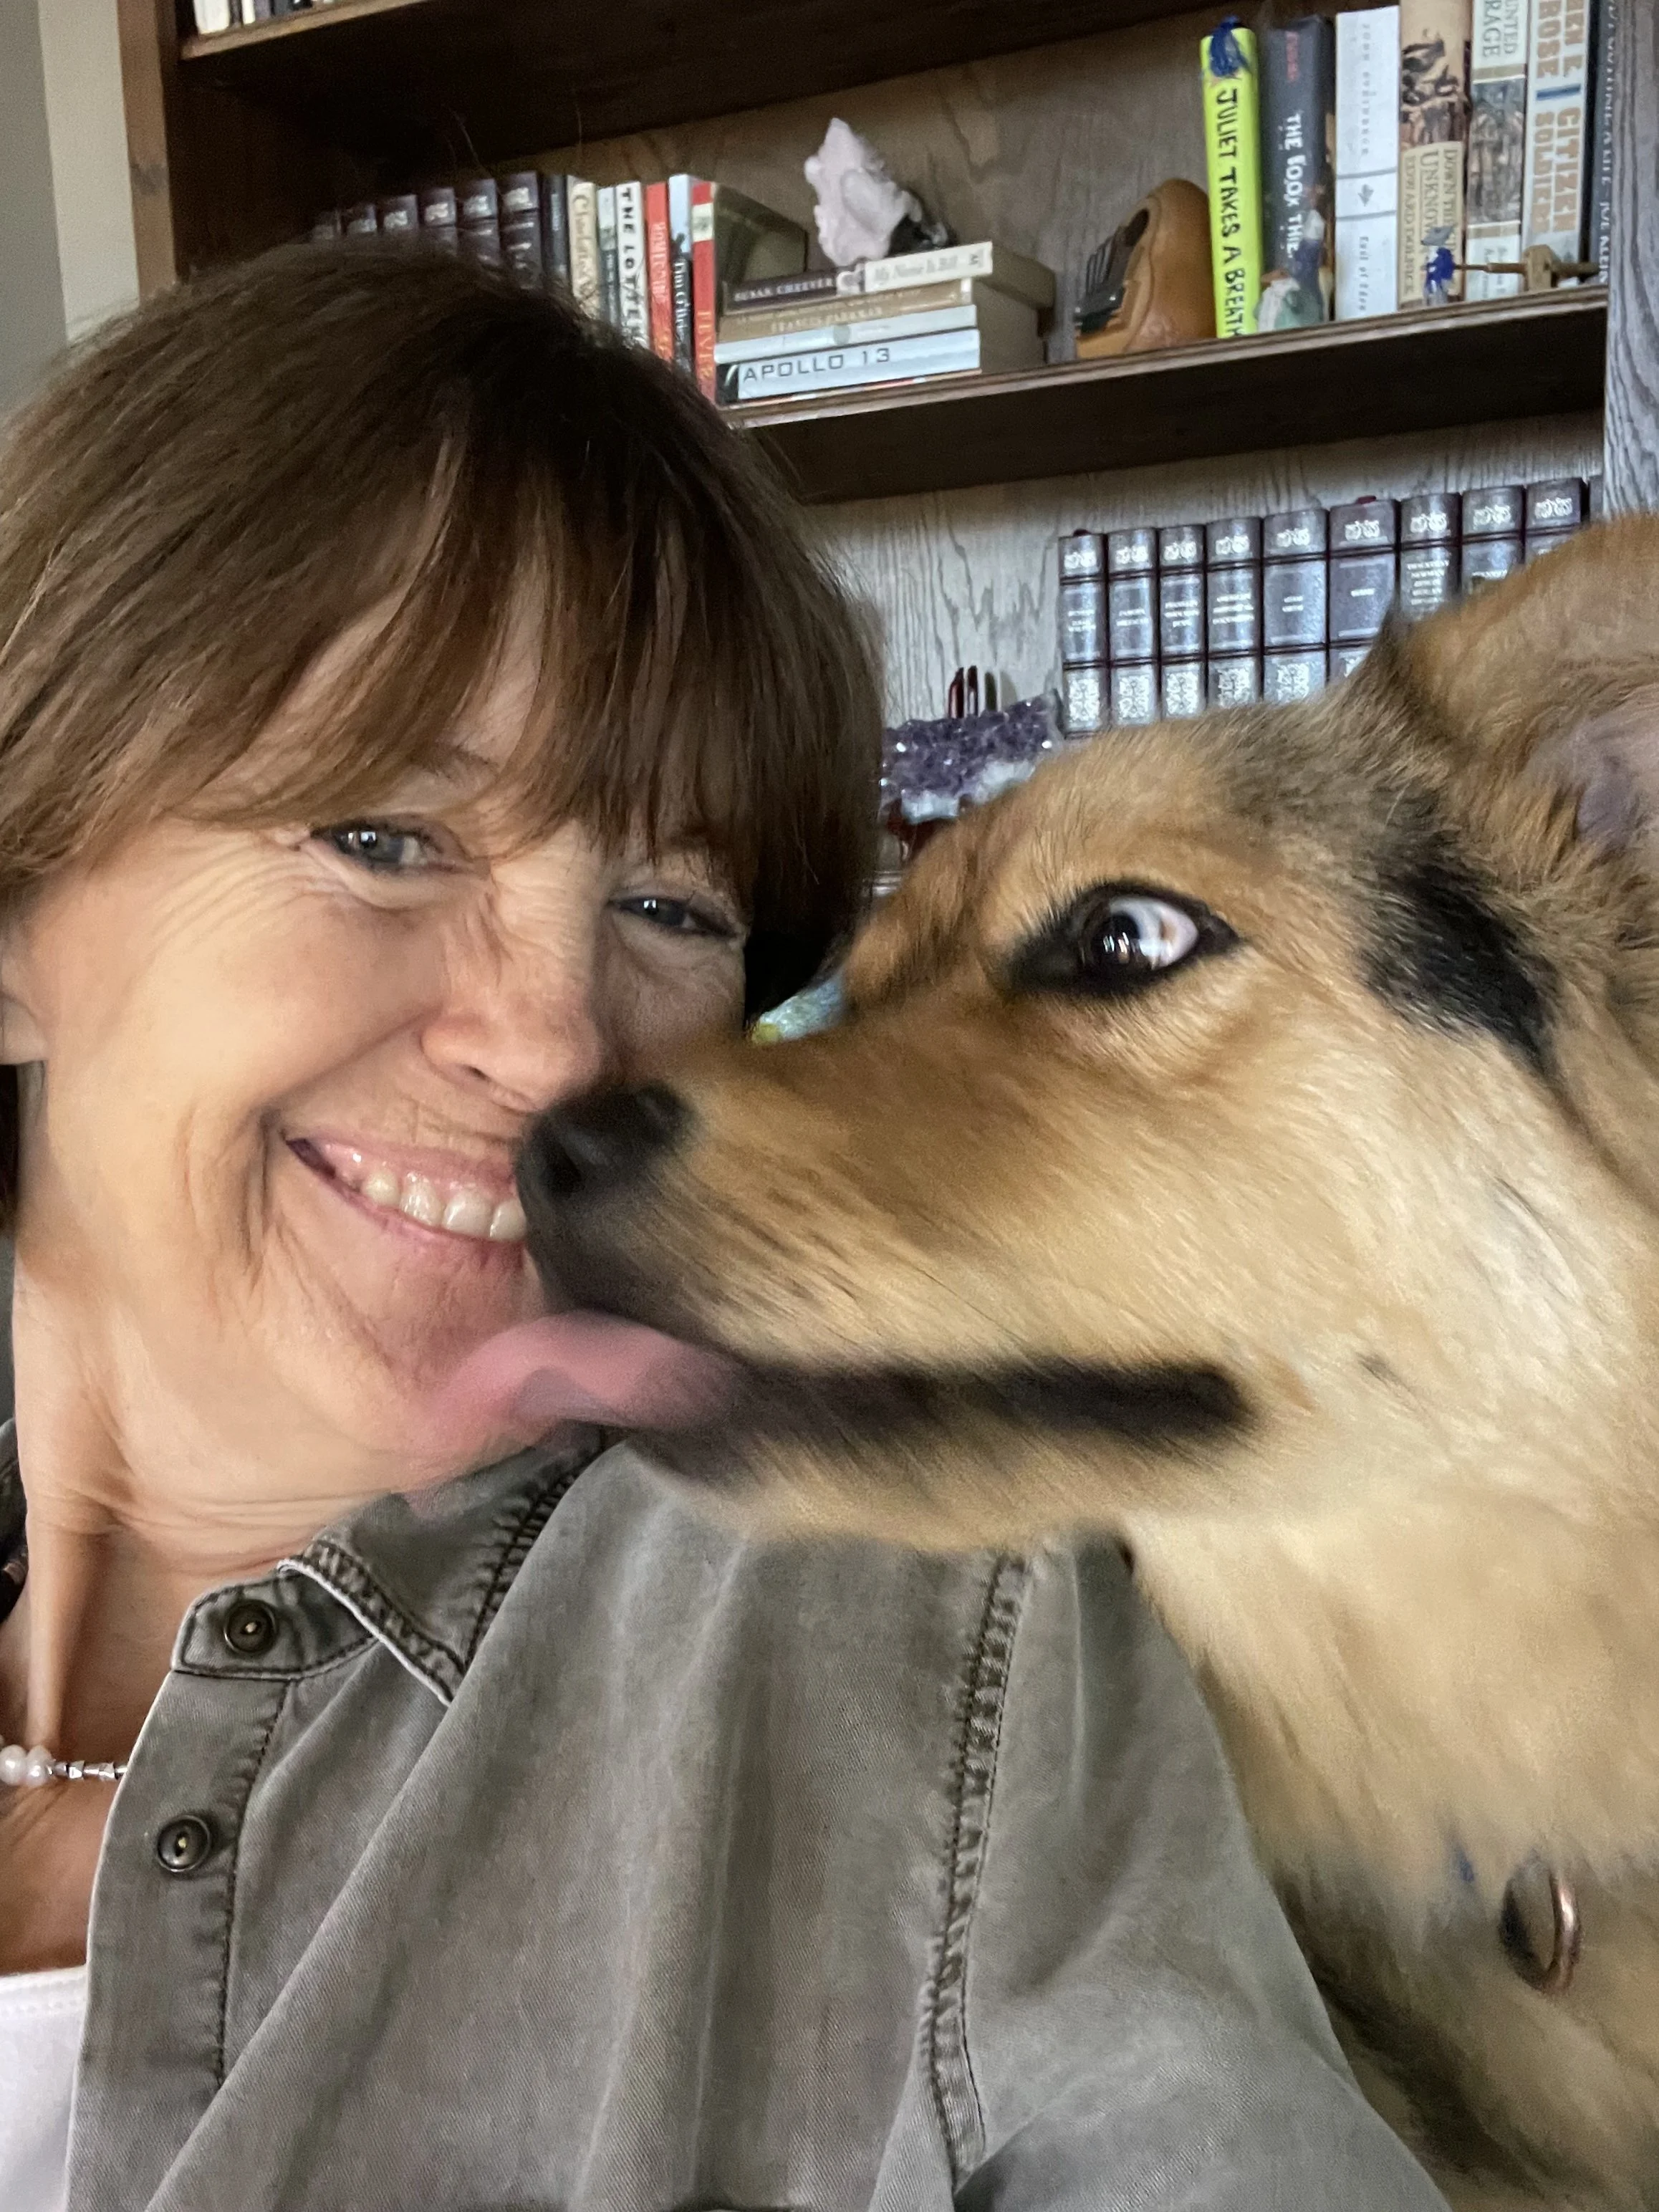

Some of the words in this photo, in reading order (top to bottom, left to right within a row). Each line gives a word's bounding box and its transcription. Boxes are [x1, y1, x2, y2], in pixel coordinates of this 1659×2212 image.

[1216, 87, 1238, 159] JULIET
[1284, 113, 1303, 150] THE
[1283, 154, 1308, 208] BOOK
[1554, 106, 1582, 231] CITIZEN
[622, 186, 636, 235] THE
[1218, 166, 1241, 238] TAKES
[1222, 245, 1244, 264] A
[742, 354, 844, 384] APOLLO
[861, 347, 890, 365] 13
